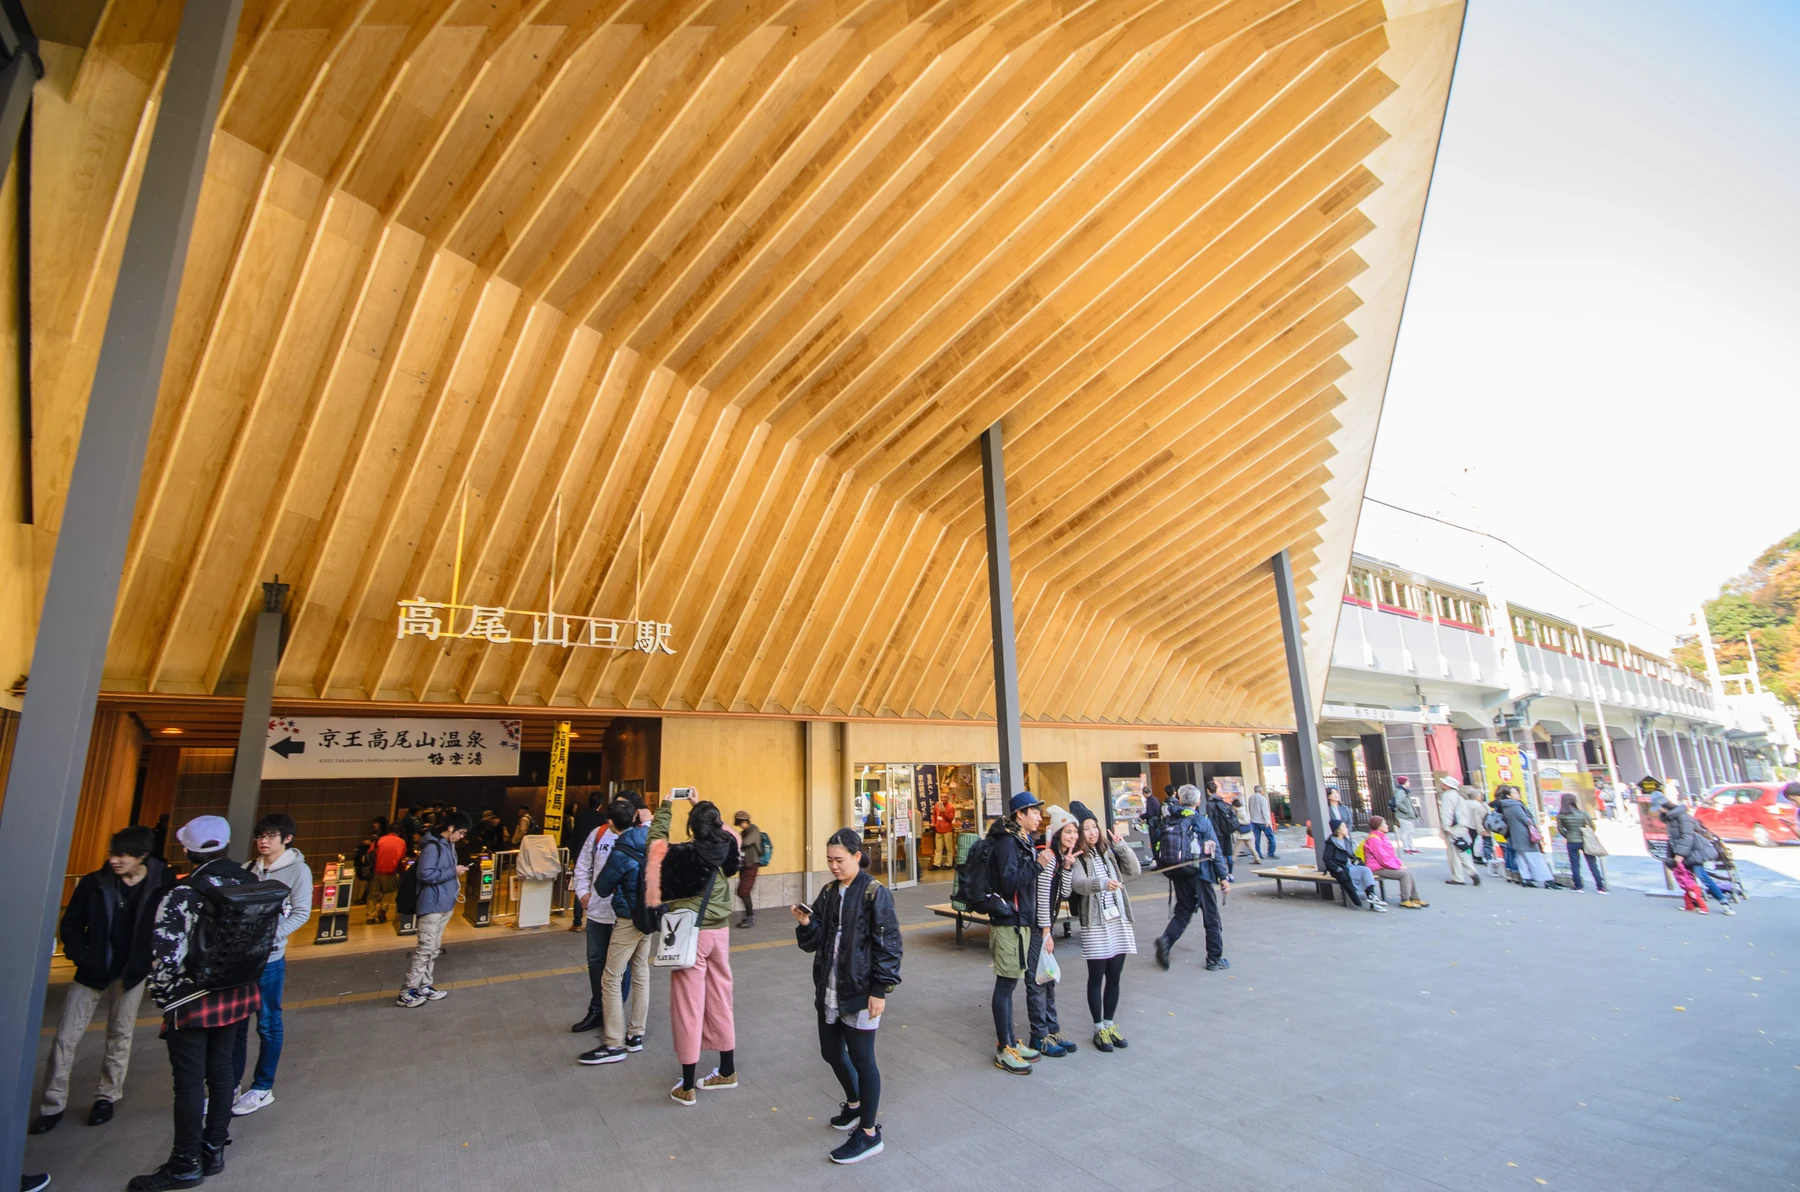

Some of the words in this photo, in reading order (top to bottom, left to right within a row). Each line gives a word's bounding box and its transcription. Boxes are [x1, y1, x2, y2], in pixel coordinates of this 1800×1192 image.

[396, 596, 678, 656] 高尾山口駅
[317, 728, 488, 750] 京王高尾山温泉
[427, 752, 484, 766] 極楽湯
